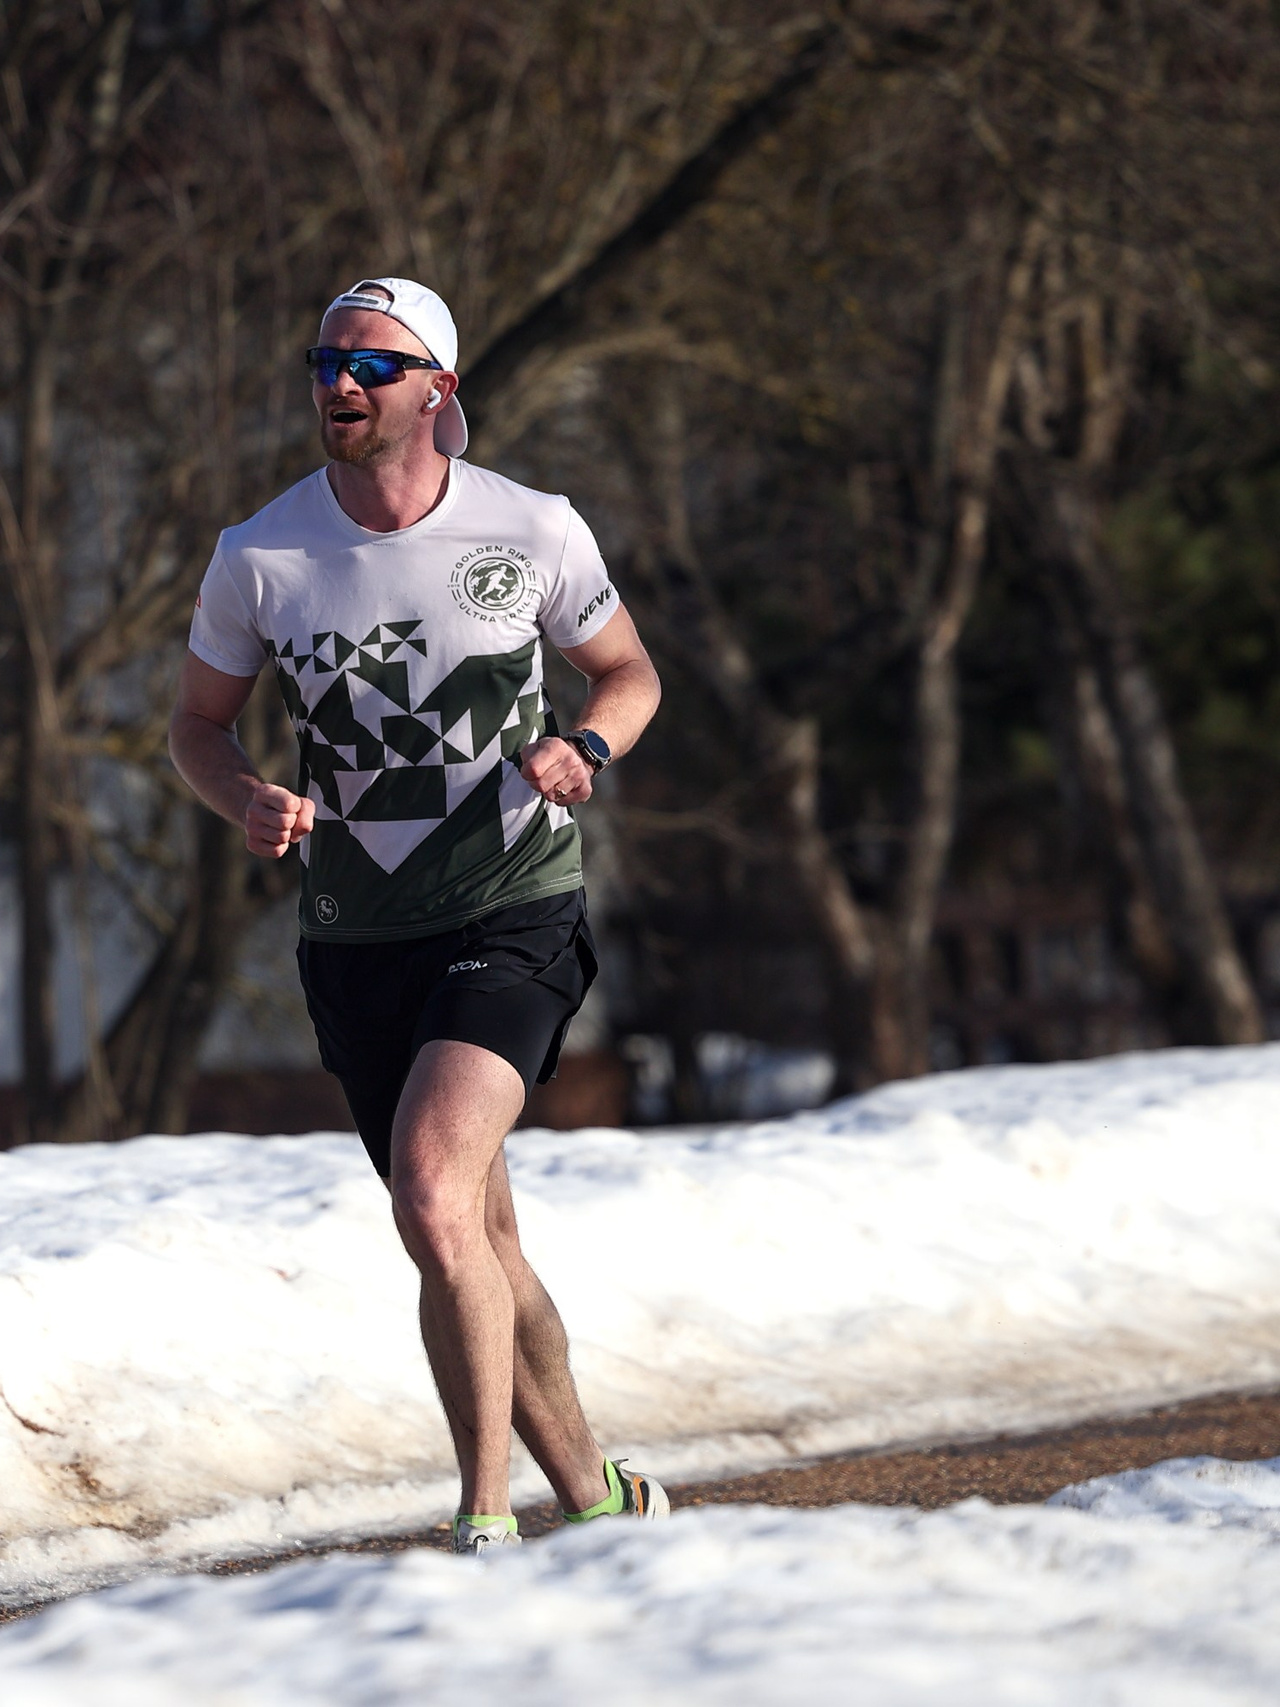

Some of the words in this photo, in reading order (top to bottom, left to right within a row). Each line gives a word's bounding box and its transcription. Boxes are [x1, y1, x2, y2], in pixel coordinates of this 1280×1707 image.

[455, 545, 503, 569] GOLDEN
[507, 547, 532, 569] RING
[459, 602, 496, 622] ULTRA
[502, 601, 530, 622] TRAIL
[578, 583, 613, 628] NEVE
